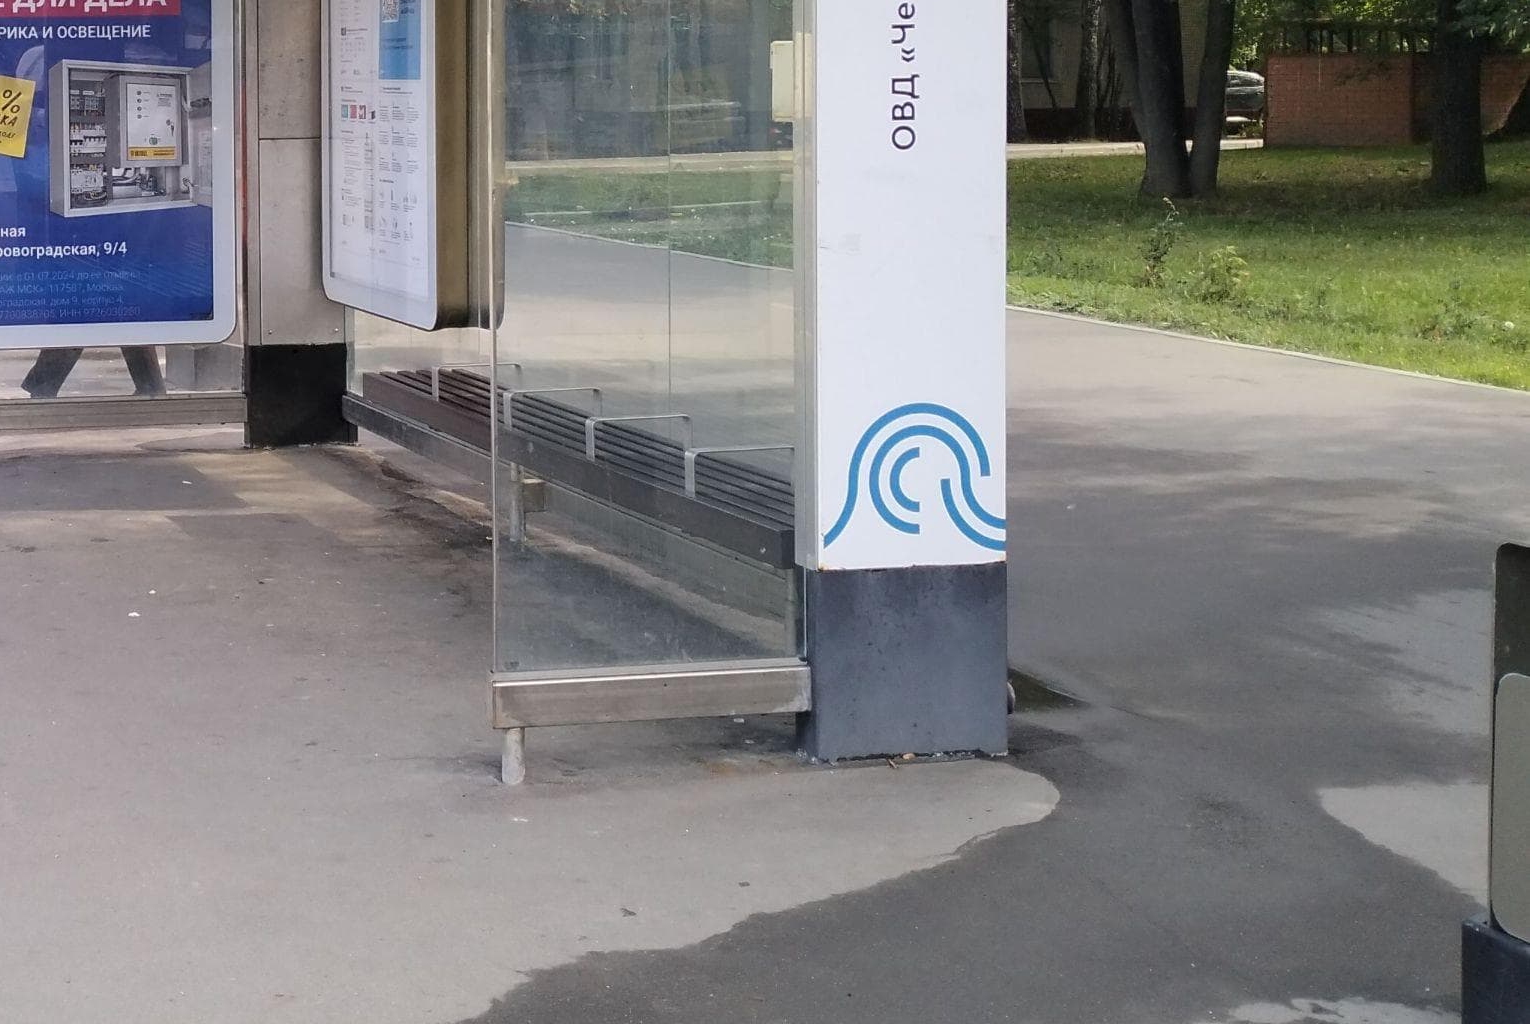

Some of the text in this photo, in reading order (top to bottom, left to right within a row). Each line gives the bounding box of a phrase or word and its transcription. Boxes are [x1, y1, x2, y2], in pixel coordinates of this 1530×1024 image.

[42, 26, 53, 38] И
[57, 25, 151, 39] ОСВЕЩЕНИЕ
[891, 74, 920, 150] ОВД
[103, 241, 128, 255] 9/4
